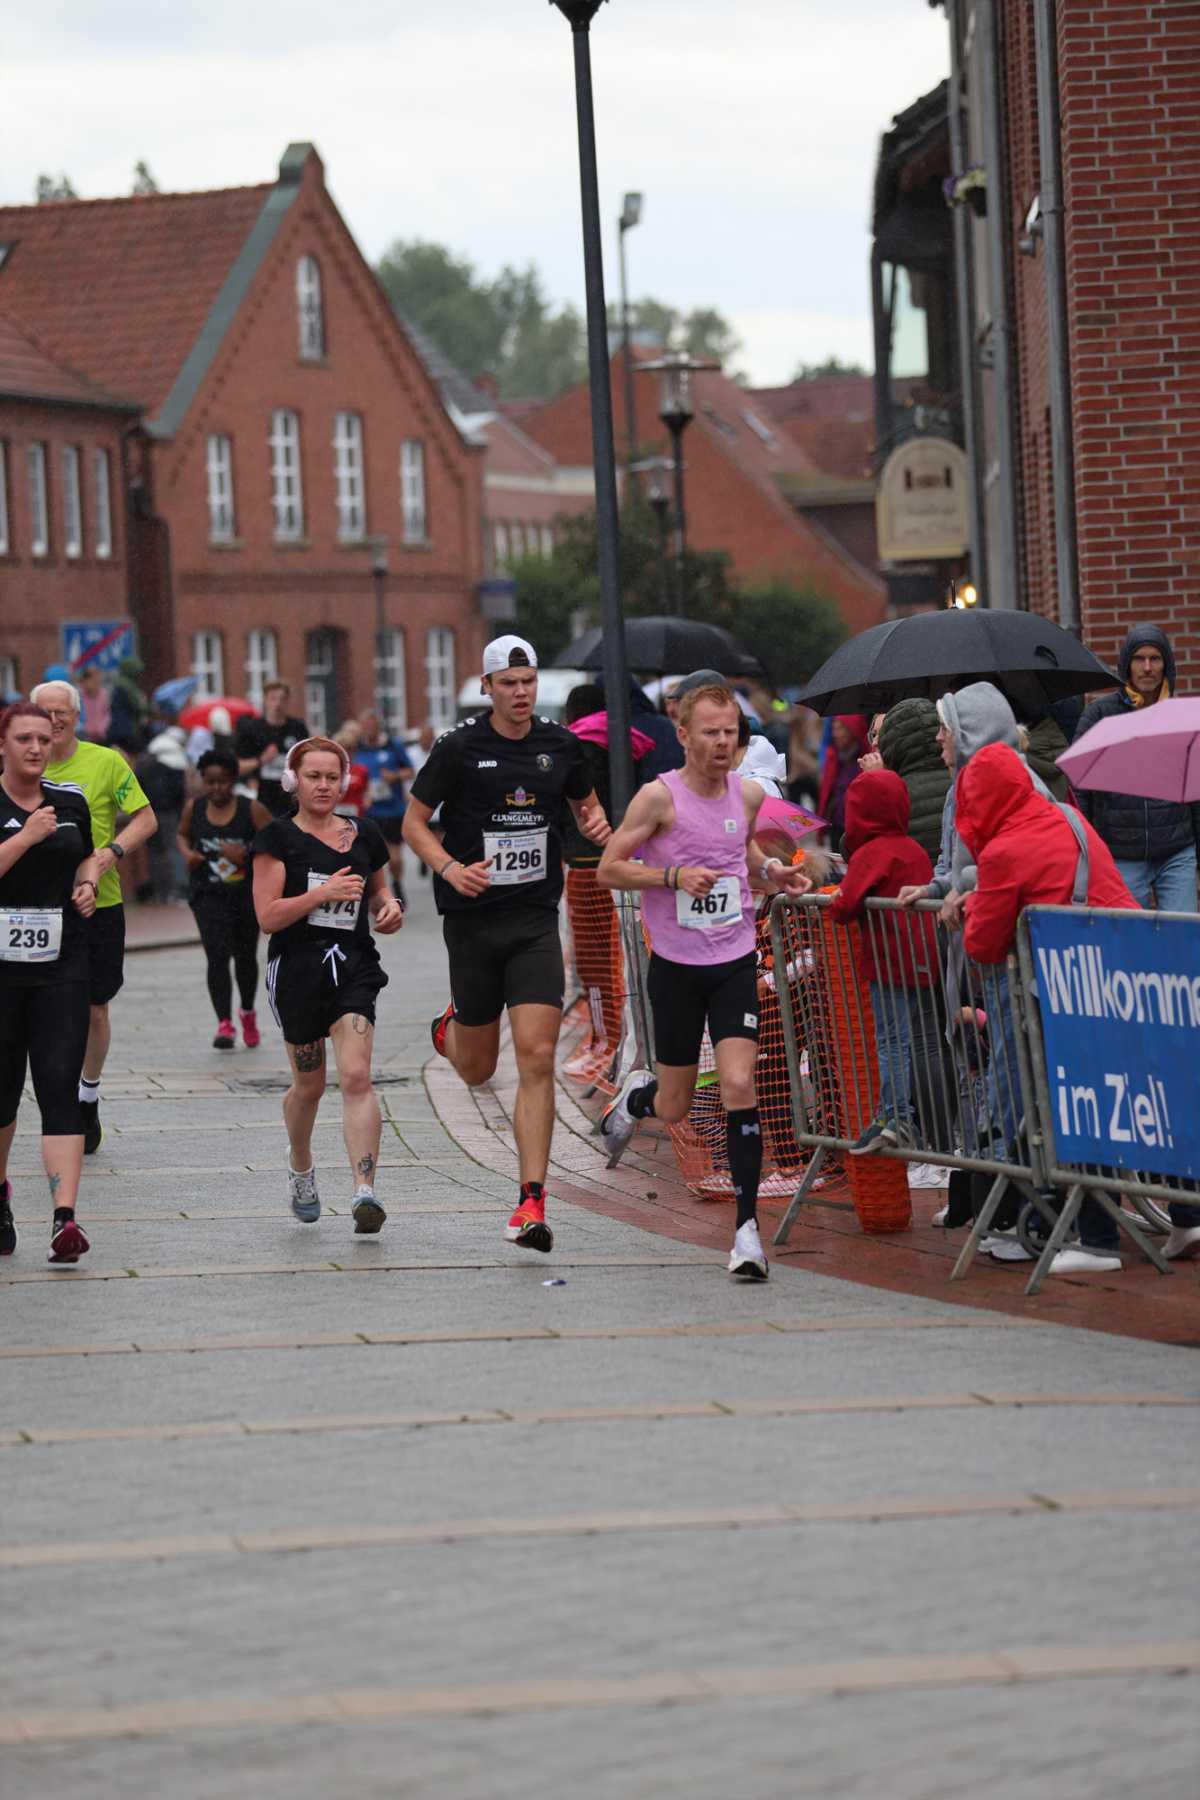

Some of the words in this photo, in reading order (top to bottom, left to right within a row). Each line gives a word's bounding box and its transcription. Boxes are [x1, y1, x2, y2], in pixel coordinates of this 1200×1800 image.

[492, 848, 541, 872] 1296
[691, 892, 728, 914] 467
[9, 928, 49, 948] 239
[1056, 1066, 1101, 1139] im
[1104, 1072, 1174, 1148] Ziel!
